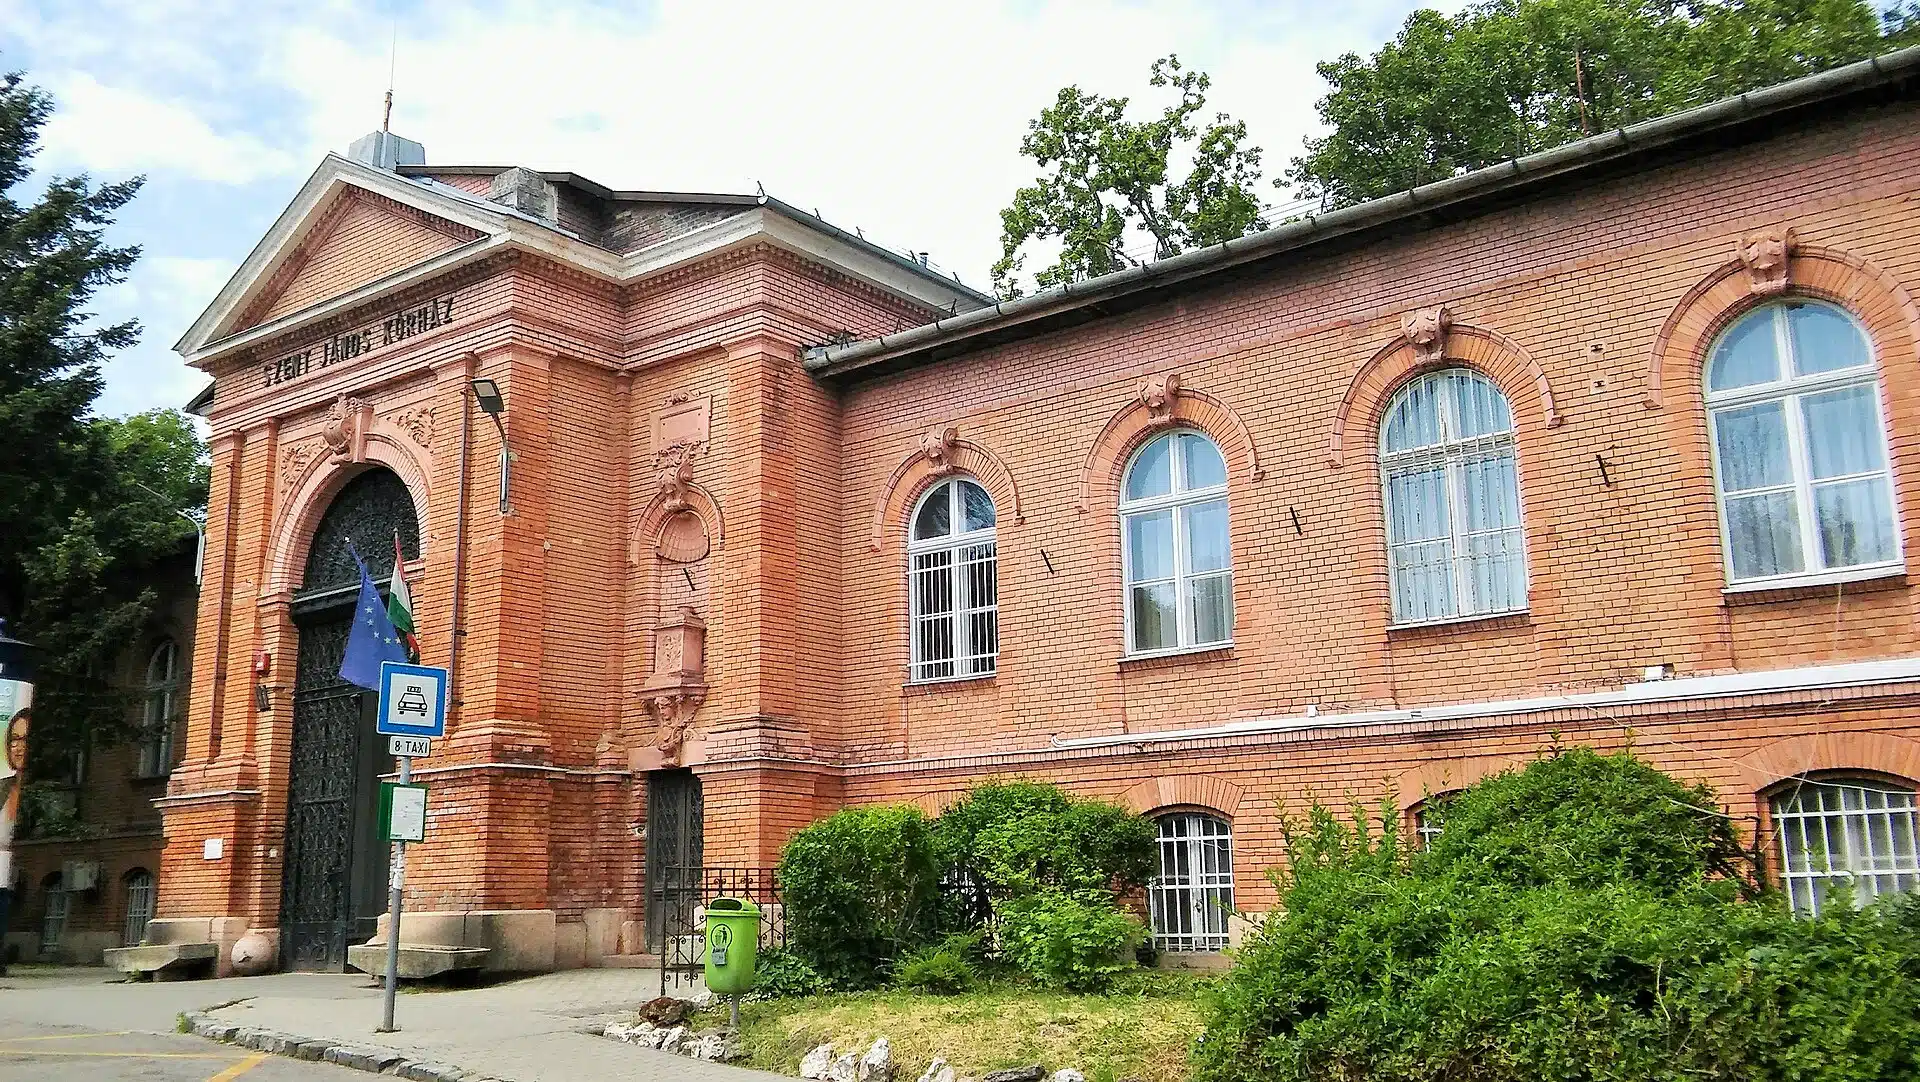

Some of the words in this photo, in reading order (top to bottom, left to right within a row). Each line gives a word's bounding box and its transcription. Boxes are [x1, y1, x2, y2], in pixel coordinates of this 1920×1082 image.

[263, 350, 312, 387] SZENT
[394, 740, 401, 752] 8
[405, 740, 428, 754] TAXI
